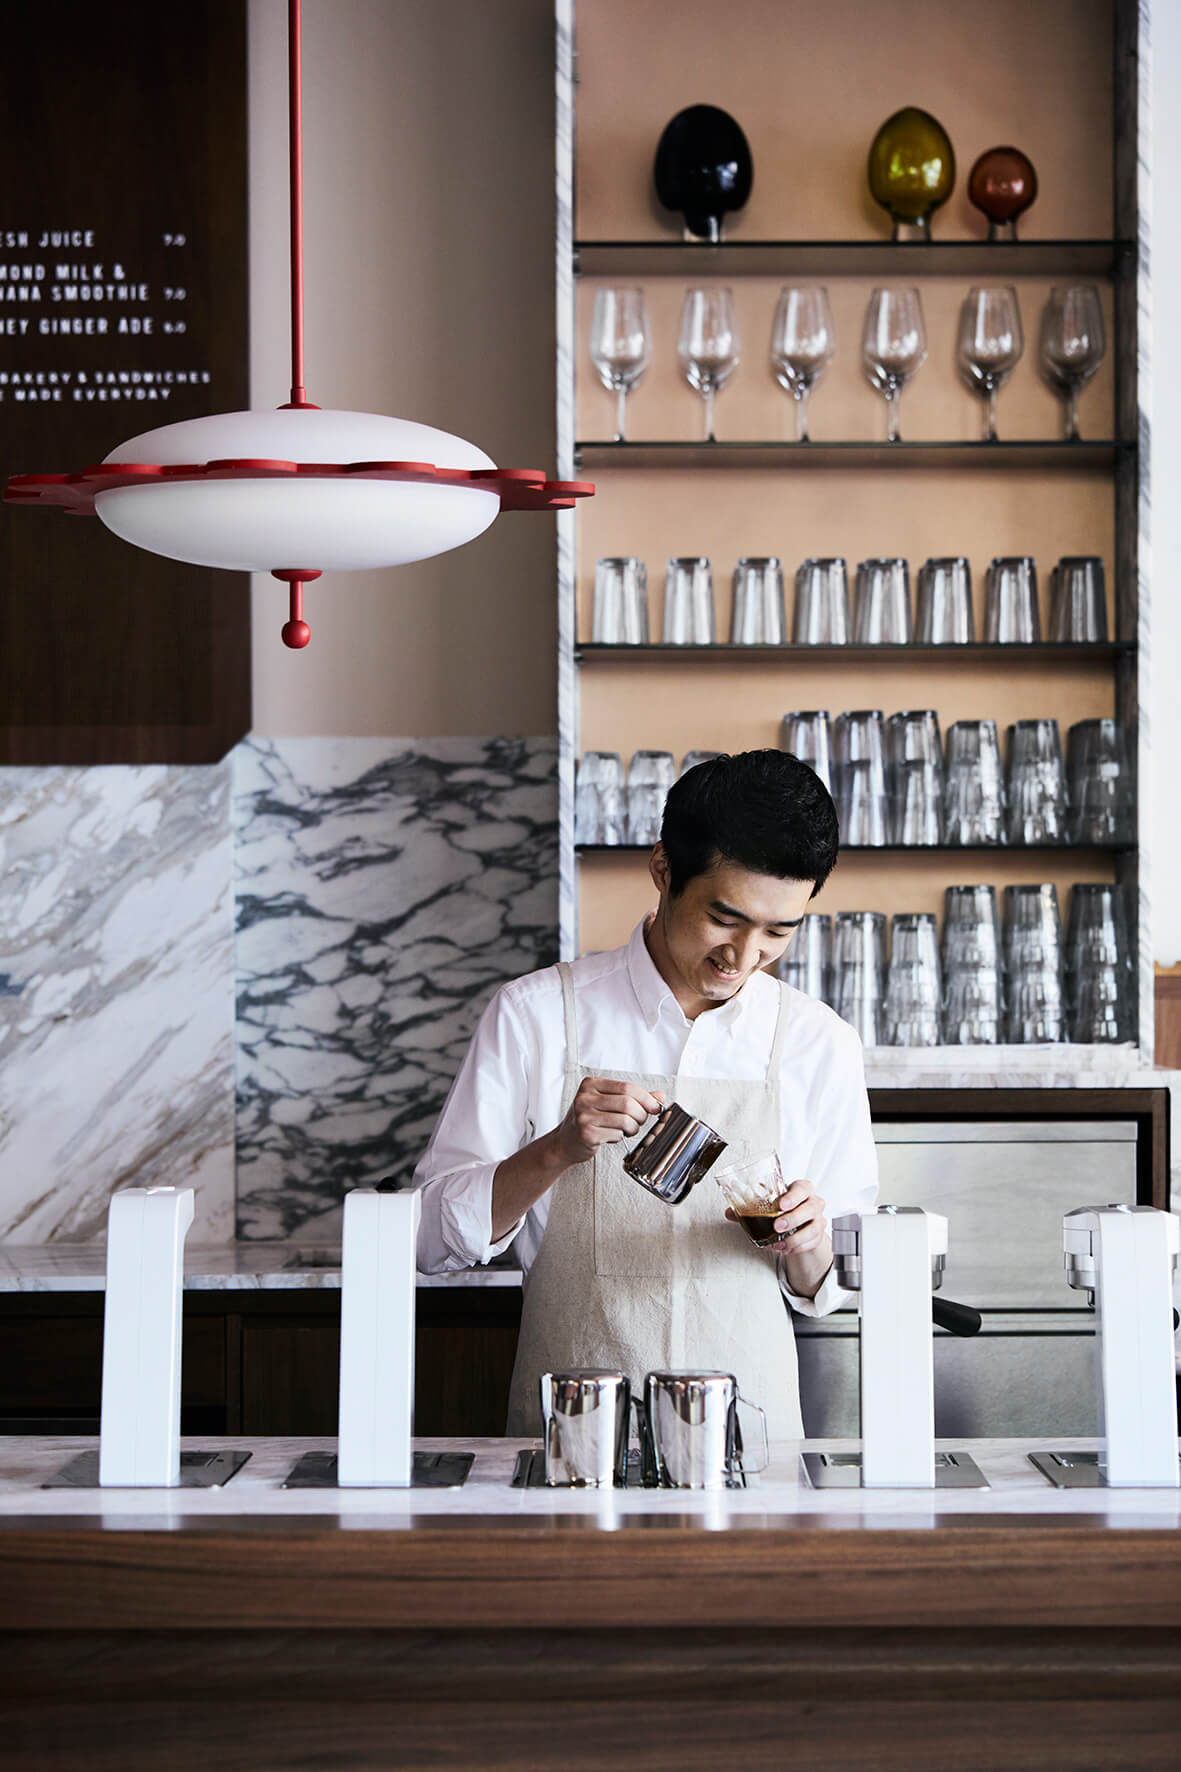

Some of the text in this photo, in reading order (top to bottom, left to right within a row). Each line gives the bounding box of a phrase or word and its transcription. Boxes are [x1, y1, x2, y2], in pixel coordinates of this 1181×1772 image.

[0, 231, 28, 247] SH
[39, 230, 94, 247] JUICE
[56, 264, 103, 280] MILK
[114, 264, 125, 280] &
[52, 284, 148, 301] SMOOTHIE
[39, 317, 108, 334] GINGER
[118, 317, 152, 334] ADE
[95, 371, 210, 384] SANDWICHES
[15, 388, 61, 401] MADE
[73, 387, 170, 401] EVERYDAY
